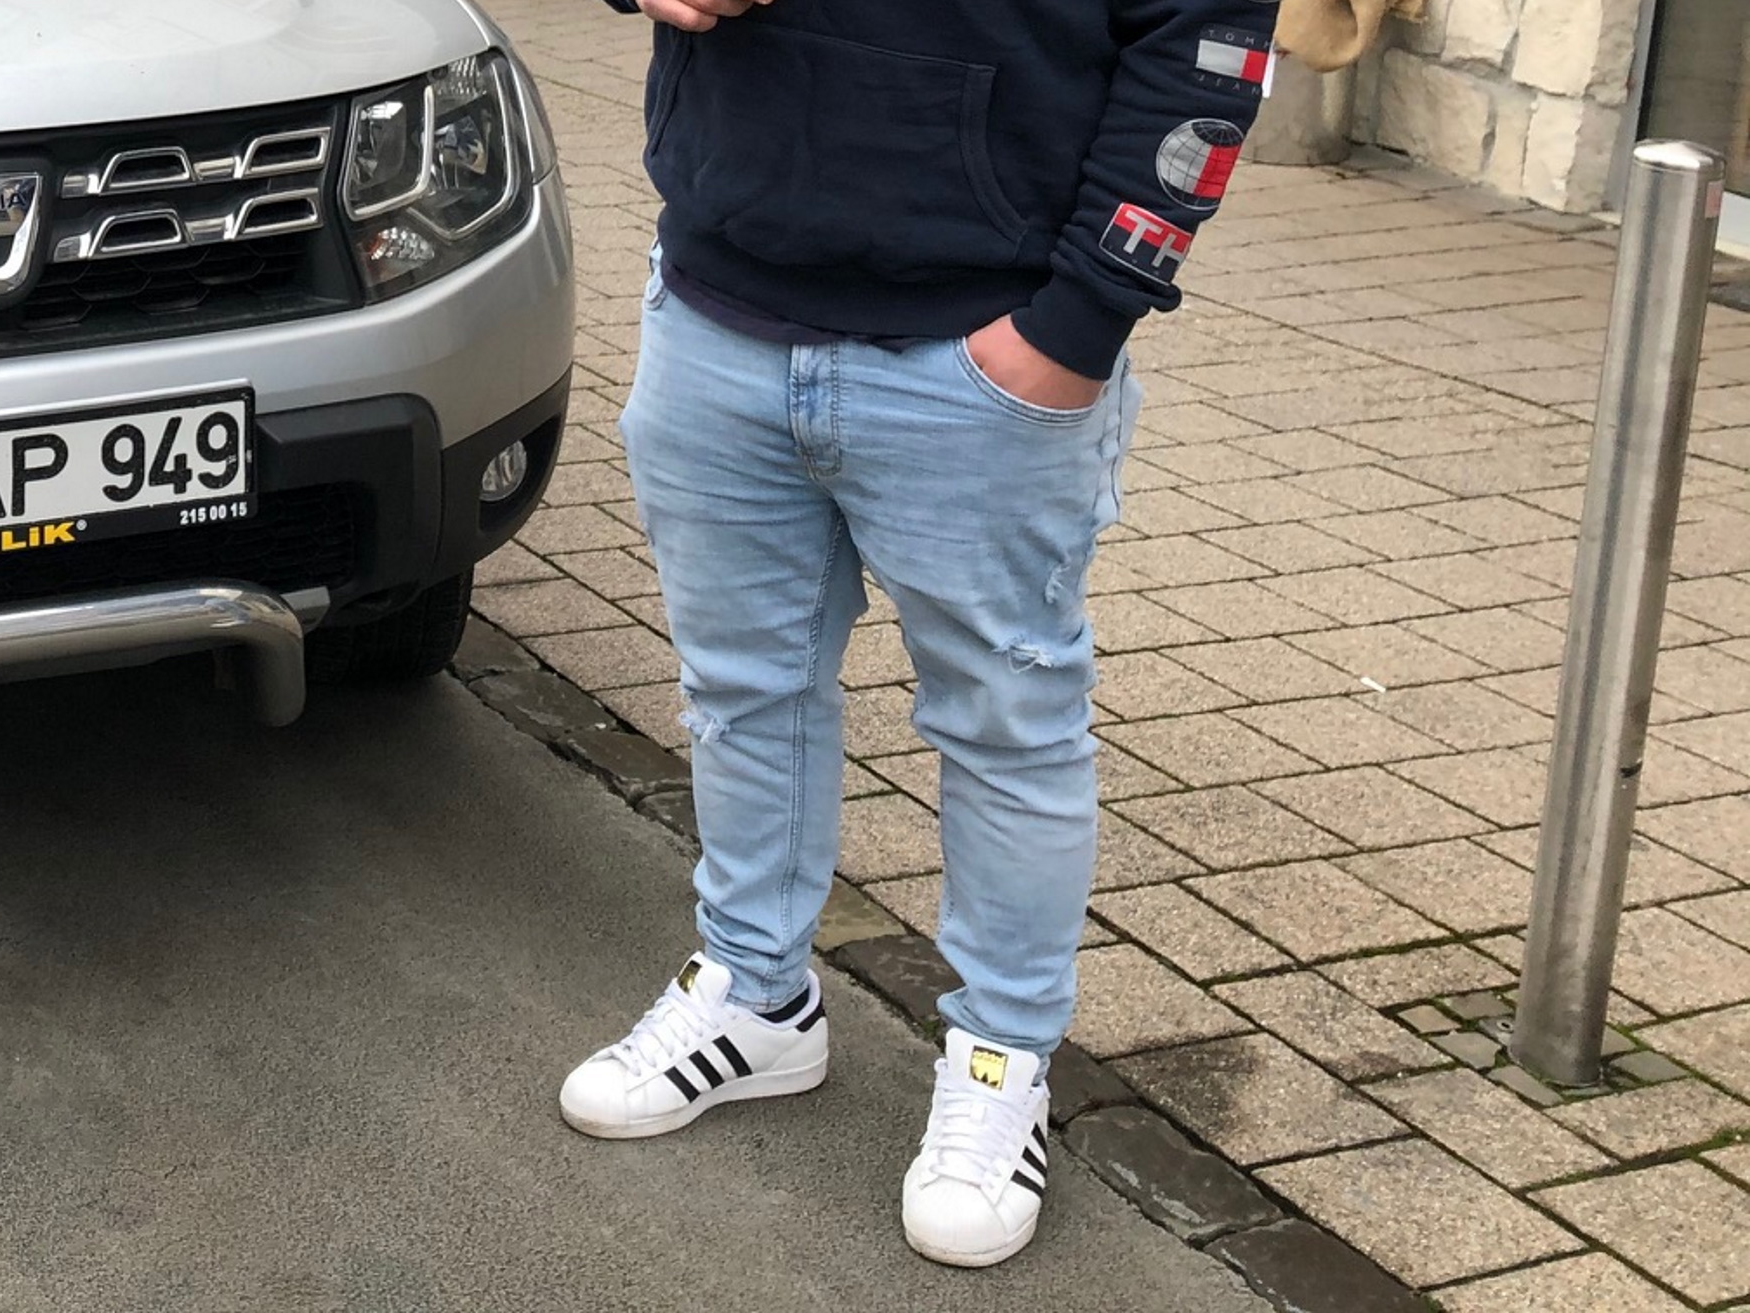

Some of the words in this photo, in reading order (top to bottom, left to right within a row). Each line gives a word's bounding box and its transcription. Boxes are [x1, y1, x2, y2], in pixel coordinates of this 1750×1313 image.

[100, 410, 239, 503] 949
[179, 507, 207, 526] 215
[209, 504, 227, 521] 00
[230, 501, 248, 518] 15
